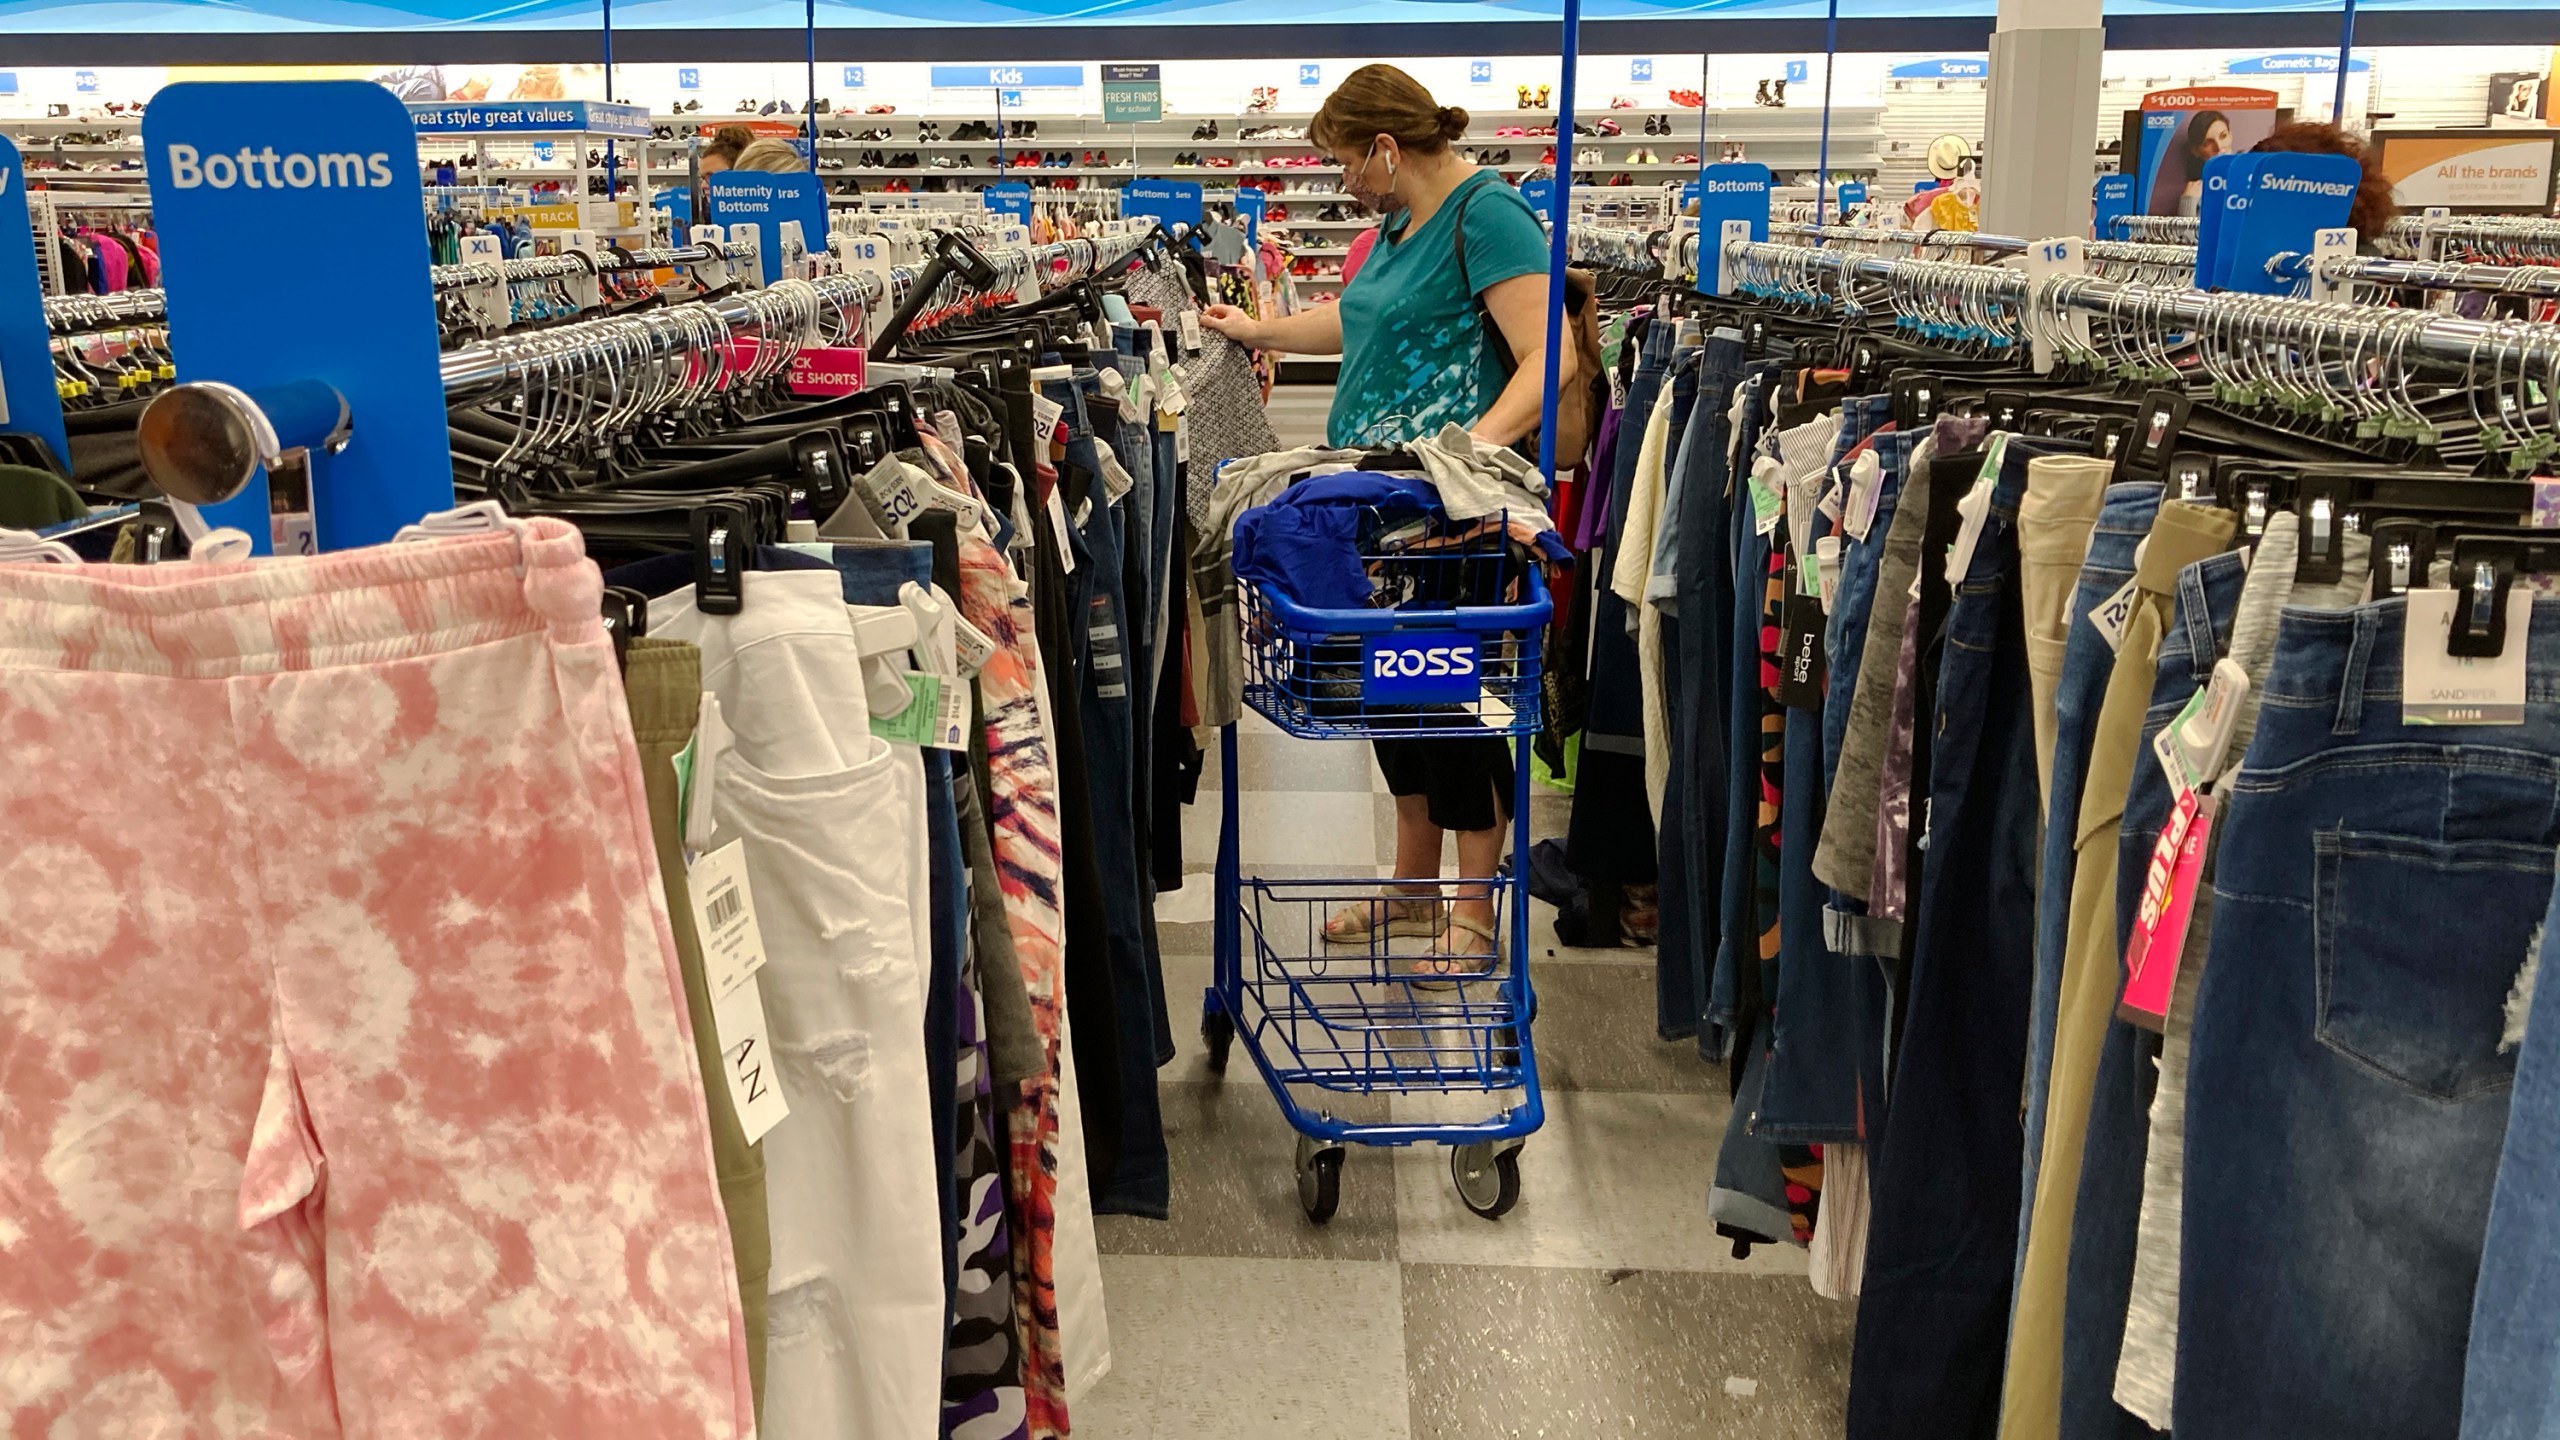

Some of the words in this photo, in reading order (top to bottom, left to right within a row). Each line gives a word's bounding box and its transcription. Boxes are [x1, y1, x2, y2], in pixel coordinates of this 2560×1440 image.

[1633, 63, 1651, 75] 5-6
[1941, 62, 1980, 74] Scarves
[2262, 57, 2312, 70] Cosmetic
[846, 71, 862, 82] 1-2
[989, 68, 1023, 84] Kids
[1301, 68, 1319, 80] 3-4
[1472, 66, 1490, 77] 5-6
[1793, 64, 1802, 77] 7
[681, 72, 697, 83] 1-2
[1003, 95, 1021, 106] 3-4
[1105, 92, 1131, 103] FRESH
[1133, 91, 1158, 103] FINDS
[2150, 95, 2196, 107] $1,000
[1115, 105, 1126, 113] for
[1127, 105, 1151, 113] school
[413, 108, 443, 125] reat
[447, 107, 481, 128] style
[485, 107, 524, 128] great
[528, 107, 574, 123] values
[589, 108, 604, 123] Great
[2147, 116, 2175, 125] ROSS
[168, 143, 393, 189] Bottoms
[2437, 165, 2457, 179] All
[2461, 165, 2485, 179] the
[2488, 165, 2538, 179] brands
[1708, 180, 1765, 193] Bottoms
[2260, 173, 2354, 197] Swimwear
[712, 185, 773, 200] Maternity
[995, 191, 1028, 200] Maternity
[1132, 188, 1170, 199] Bottoms
[1175, 191, 1191, 199] Sets
[1529, 189, 1546, 198] Tops
[2105, 191, 2126, 199] Pants
[718, 201, 770, 213] Bottoms
[1004, 199, 1020, 208] Tops
[540, 211, 575, 223] RACK
[2431, 210, 2442, 218] M
[740, 226, 748, 236] S
[1109, 223, 1119, 231] 22
[1729, 223, 1742, 234] 14
[703, 228, 715, 239] M
[1005, 230, 1020, 242] 20
[2324, 232, 2347, 246] 2X
[573, 234, 582, 246] L
[471, 239, 493, 254] XL
[854, 243, 876, 259] 18
[2043, 242, 2067, 261] 16
[807, 373, 859, 386] SHORTS
[1612, 372, 1624, 406] ROSS
[881, 485, 919, 527] ROS
[1787, 563, 1797, 571] ZA
[1374, 646, 1475, 678] ROSS
[1799, 633, 1815, 684] bebe
[2430, 688, 2497, 700] SANDPIPER
[2447, 708, 2482, 719] RAYON
[2140, 811, 2189, 932] PLUS
